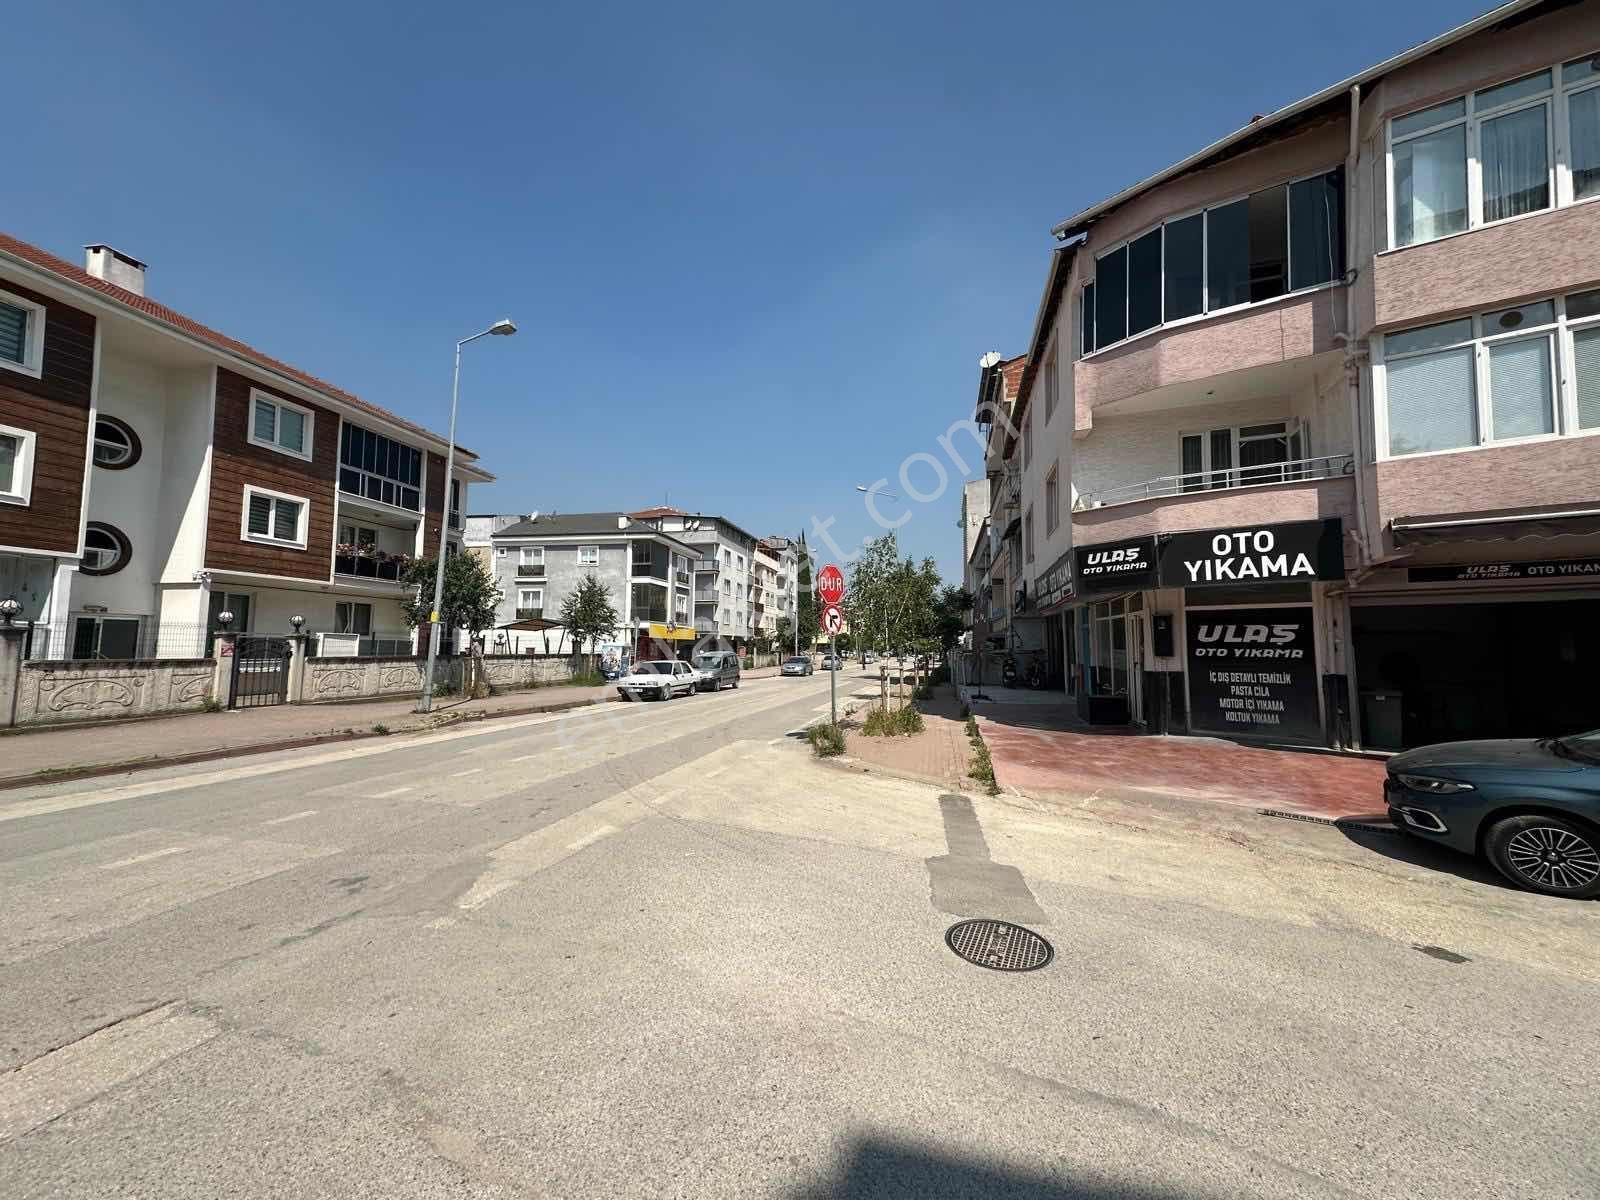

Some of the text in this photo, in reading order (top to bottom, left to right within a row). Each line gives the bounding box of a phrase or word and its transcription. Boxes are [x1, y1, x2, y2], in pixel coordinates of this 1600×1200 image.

[1212, 530, 1275, 556] OTO
[1087, 547, 1141, 565] ULAŞ
[1083, 562, 1148, 575] OTO YIKAMA
[1184, 553, 1316, 582] YIKAMA
[1528, 565, 1555, 575] OTO
[821, 577, 842, 592] DUR
[1197, 624, 1300, 646] ULAŞ
[1195, 648, 1305, 659] OTO YIKAMA
[1209, 670, 1217, 684] İÇ
[1230, 671, 1257, 683] DETAYLI
[1258, 671, 1291, 685] TEMİZLİK
[1230, 685, 1253, 697] PASTA
[1219, 698, 1244, 709] MOTOR
[1256, 699, 1285, 711] YIKAMA
[1225, 711, 1250, 723] KOLTUK
